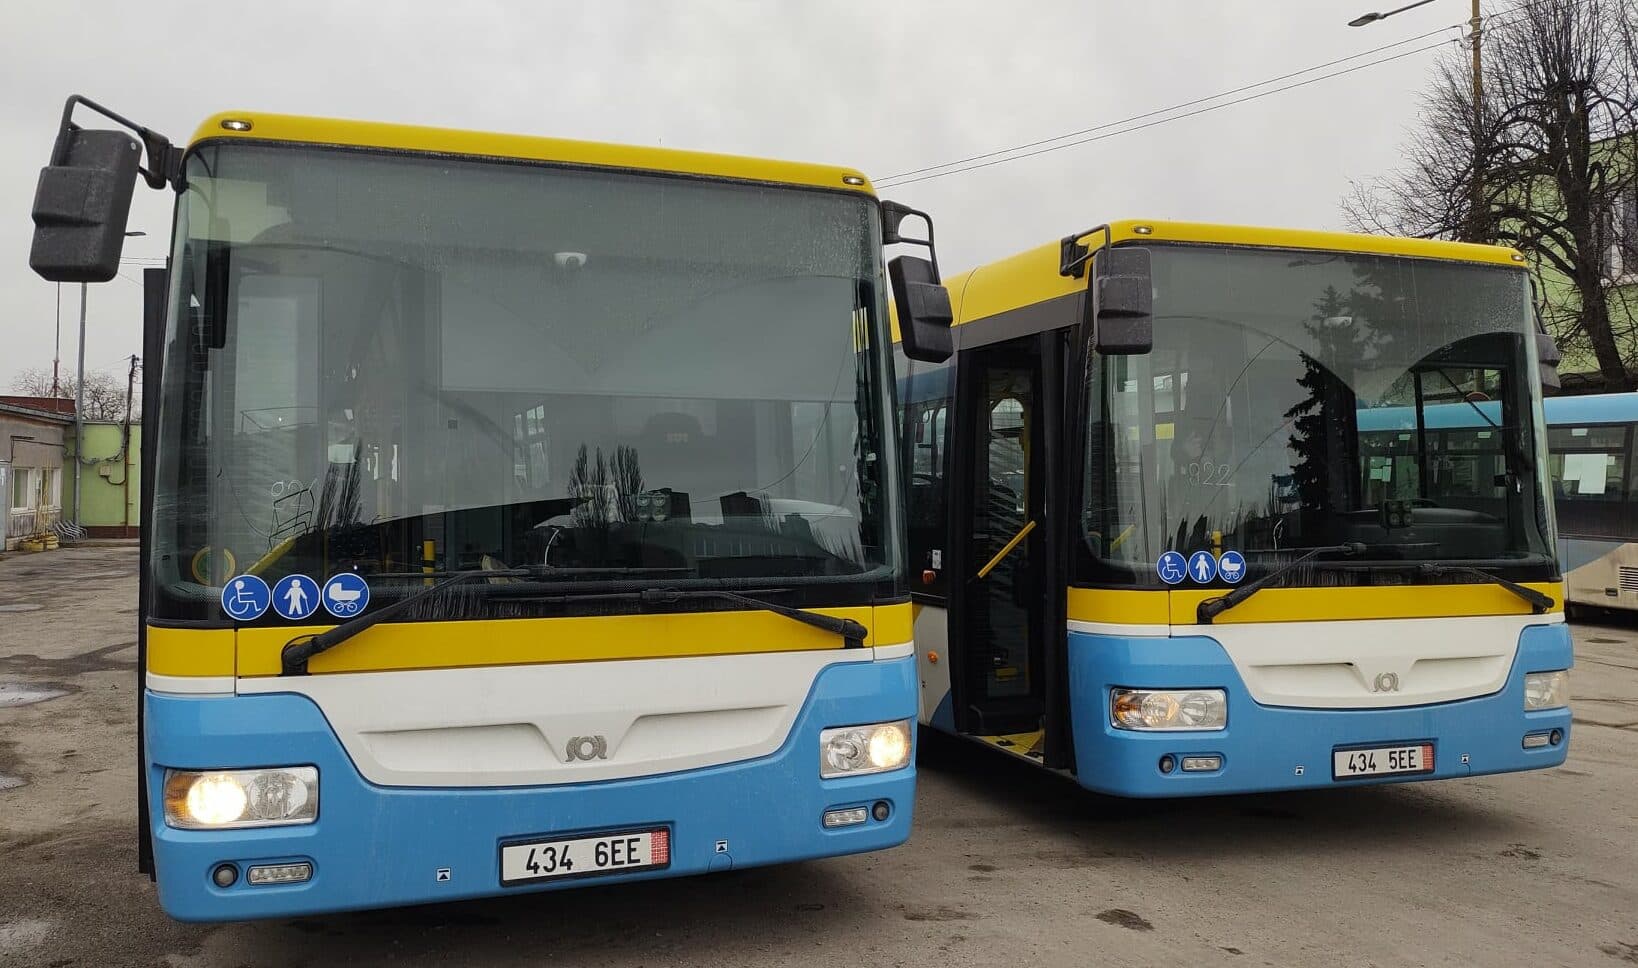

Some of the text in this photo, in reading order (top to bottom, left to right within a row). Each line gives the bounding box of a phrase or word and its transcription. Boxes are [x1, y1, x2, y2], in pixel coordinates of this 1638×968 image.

[1348, 749, 1417, 773] 434 5EE
[526, 845, 573, 874] 434
[595, 838, 641, 867] 6EE
